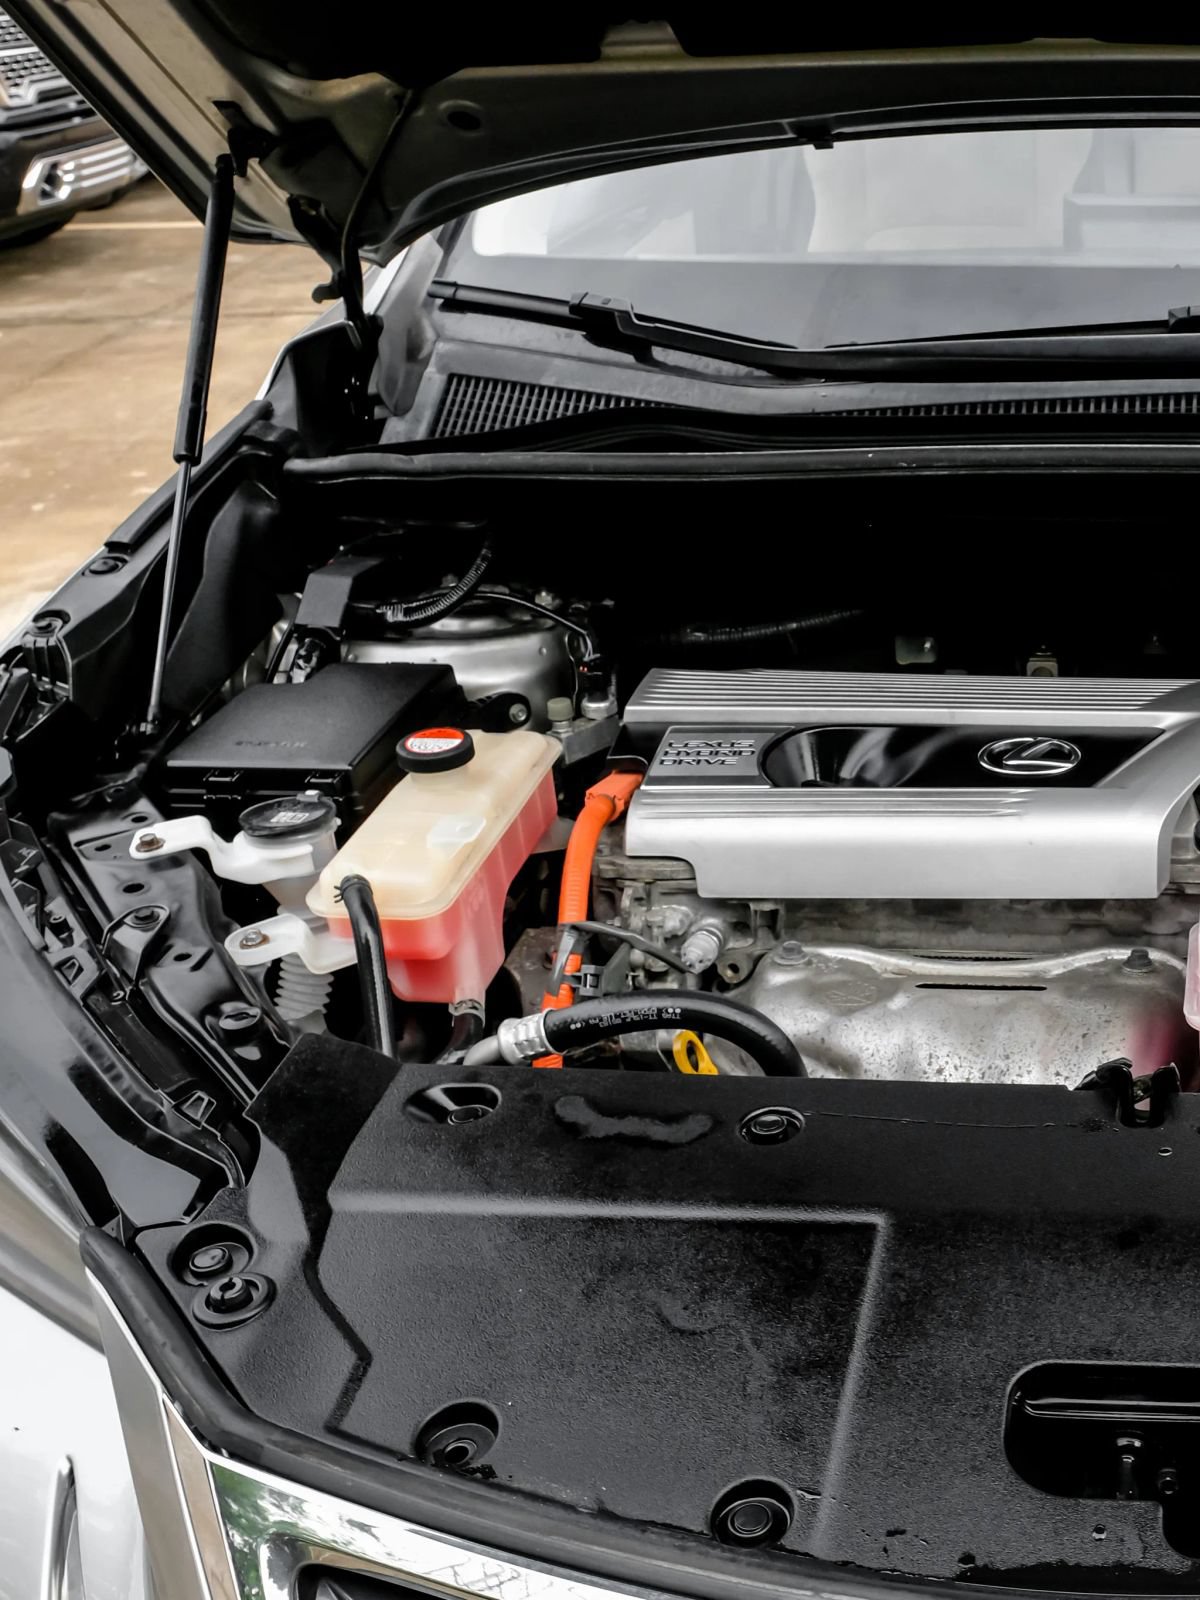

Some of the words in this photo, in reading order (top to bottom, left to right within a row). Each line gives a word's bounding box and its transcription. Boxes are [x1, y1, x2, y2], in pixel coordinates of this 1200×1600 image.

[668, 740, 755, 748] LEXUS
[663, 748, 757, 756] HYBRID
[659, 757, 738, 765] DRIVE
